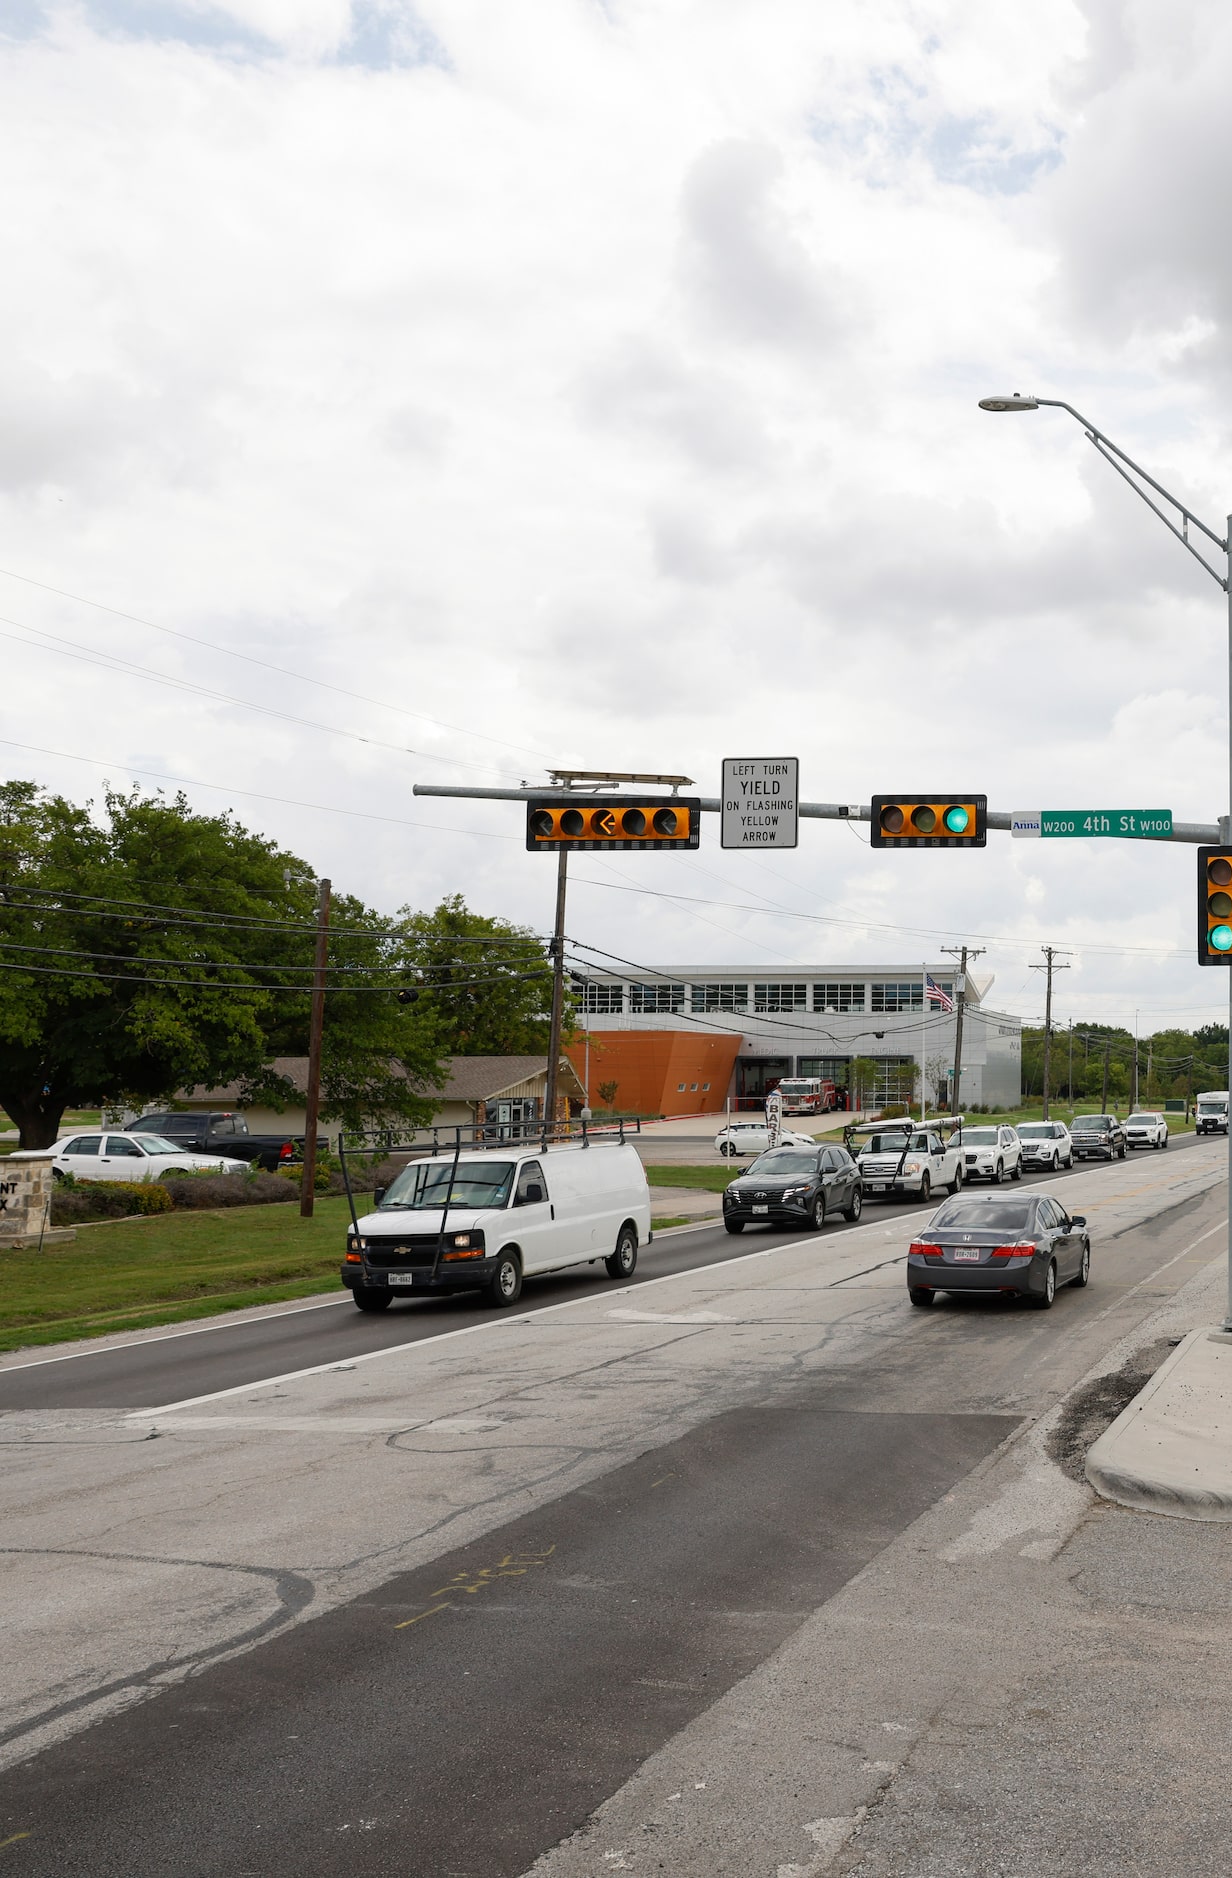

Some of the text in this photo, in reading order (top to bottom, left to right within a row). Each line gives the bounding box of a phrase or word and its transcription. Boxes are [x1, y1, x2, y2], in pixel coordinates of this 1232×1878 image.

[733, 765, 788, 776] LEFT TURN
[741, 781, 780, 795] YIELD
[727, 800, 793, 811] ON FLASHING
[741, 816, 779, 826] YELLOW
[1013, 821, 1040, 830] Anna
[1043, 815, 1171, 832] W200 4th St W100
[743, 831, 776, 841] ARROW
